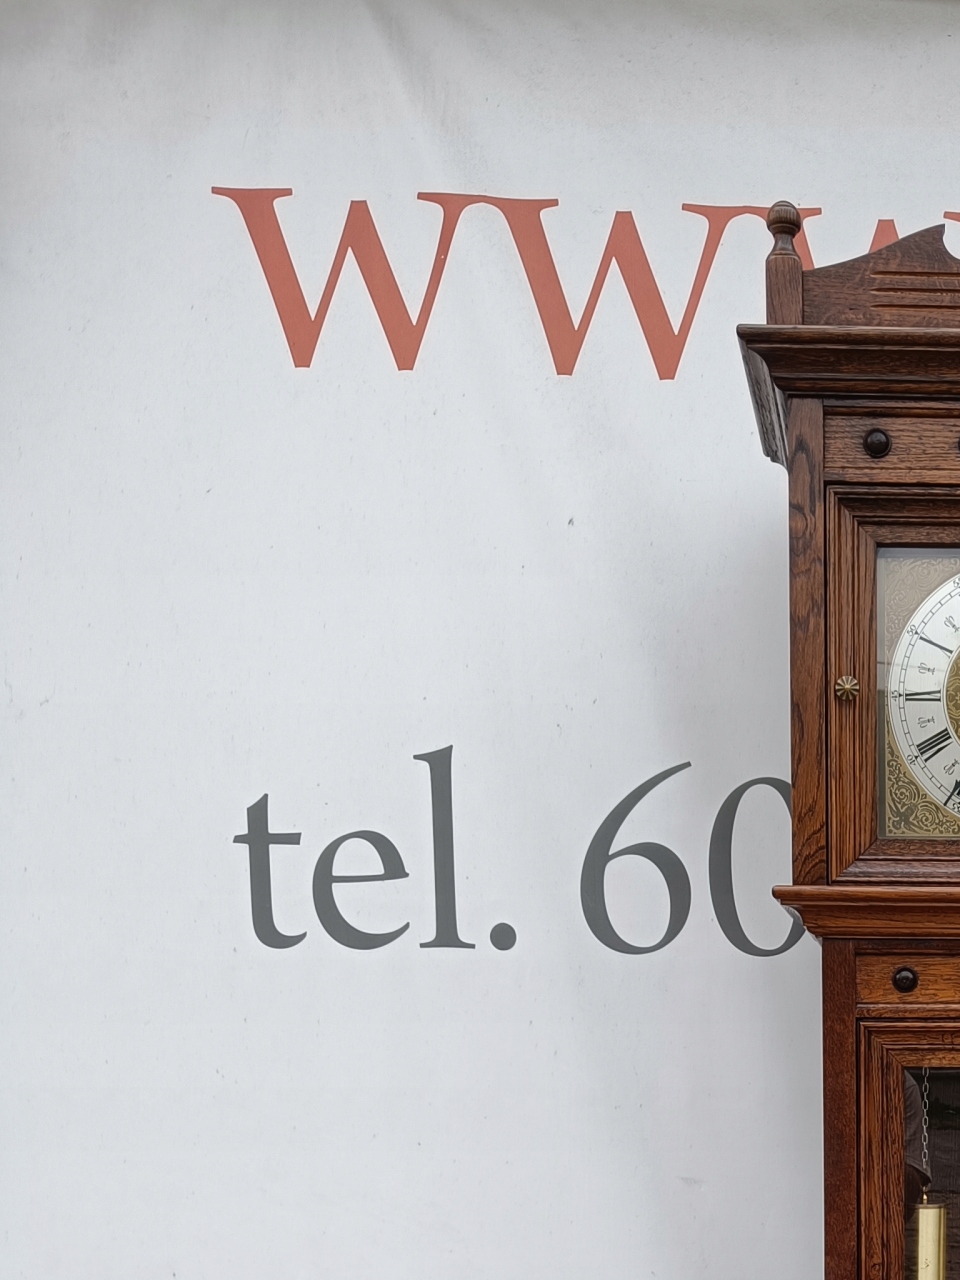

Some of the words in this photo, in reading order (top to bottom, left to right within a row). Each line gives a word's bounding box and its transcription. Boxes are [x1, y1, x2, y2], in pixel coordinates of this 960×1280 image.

[906, 624, 917, 637] 50
[919, 631, 954, 659] X
[904, 688, 942, 702] IX
[916, 727, 954, 763] VIII
[906, 754, 916, 766] 40
[233, 745, 516, 955] tel.
